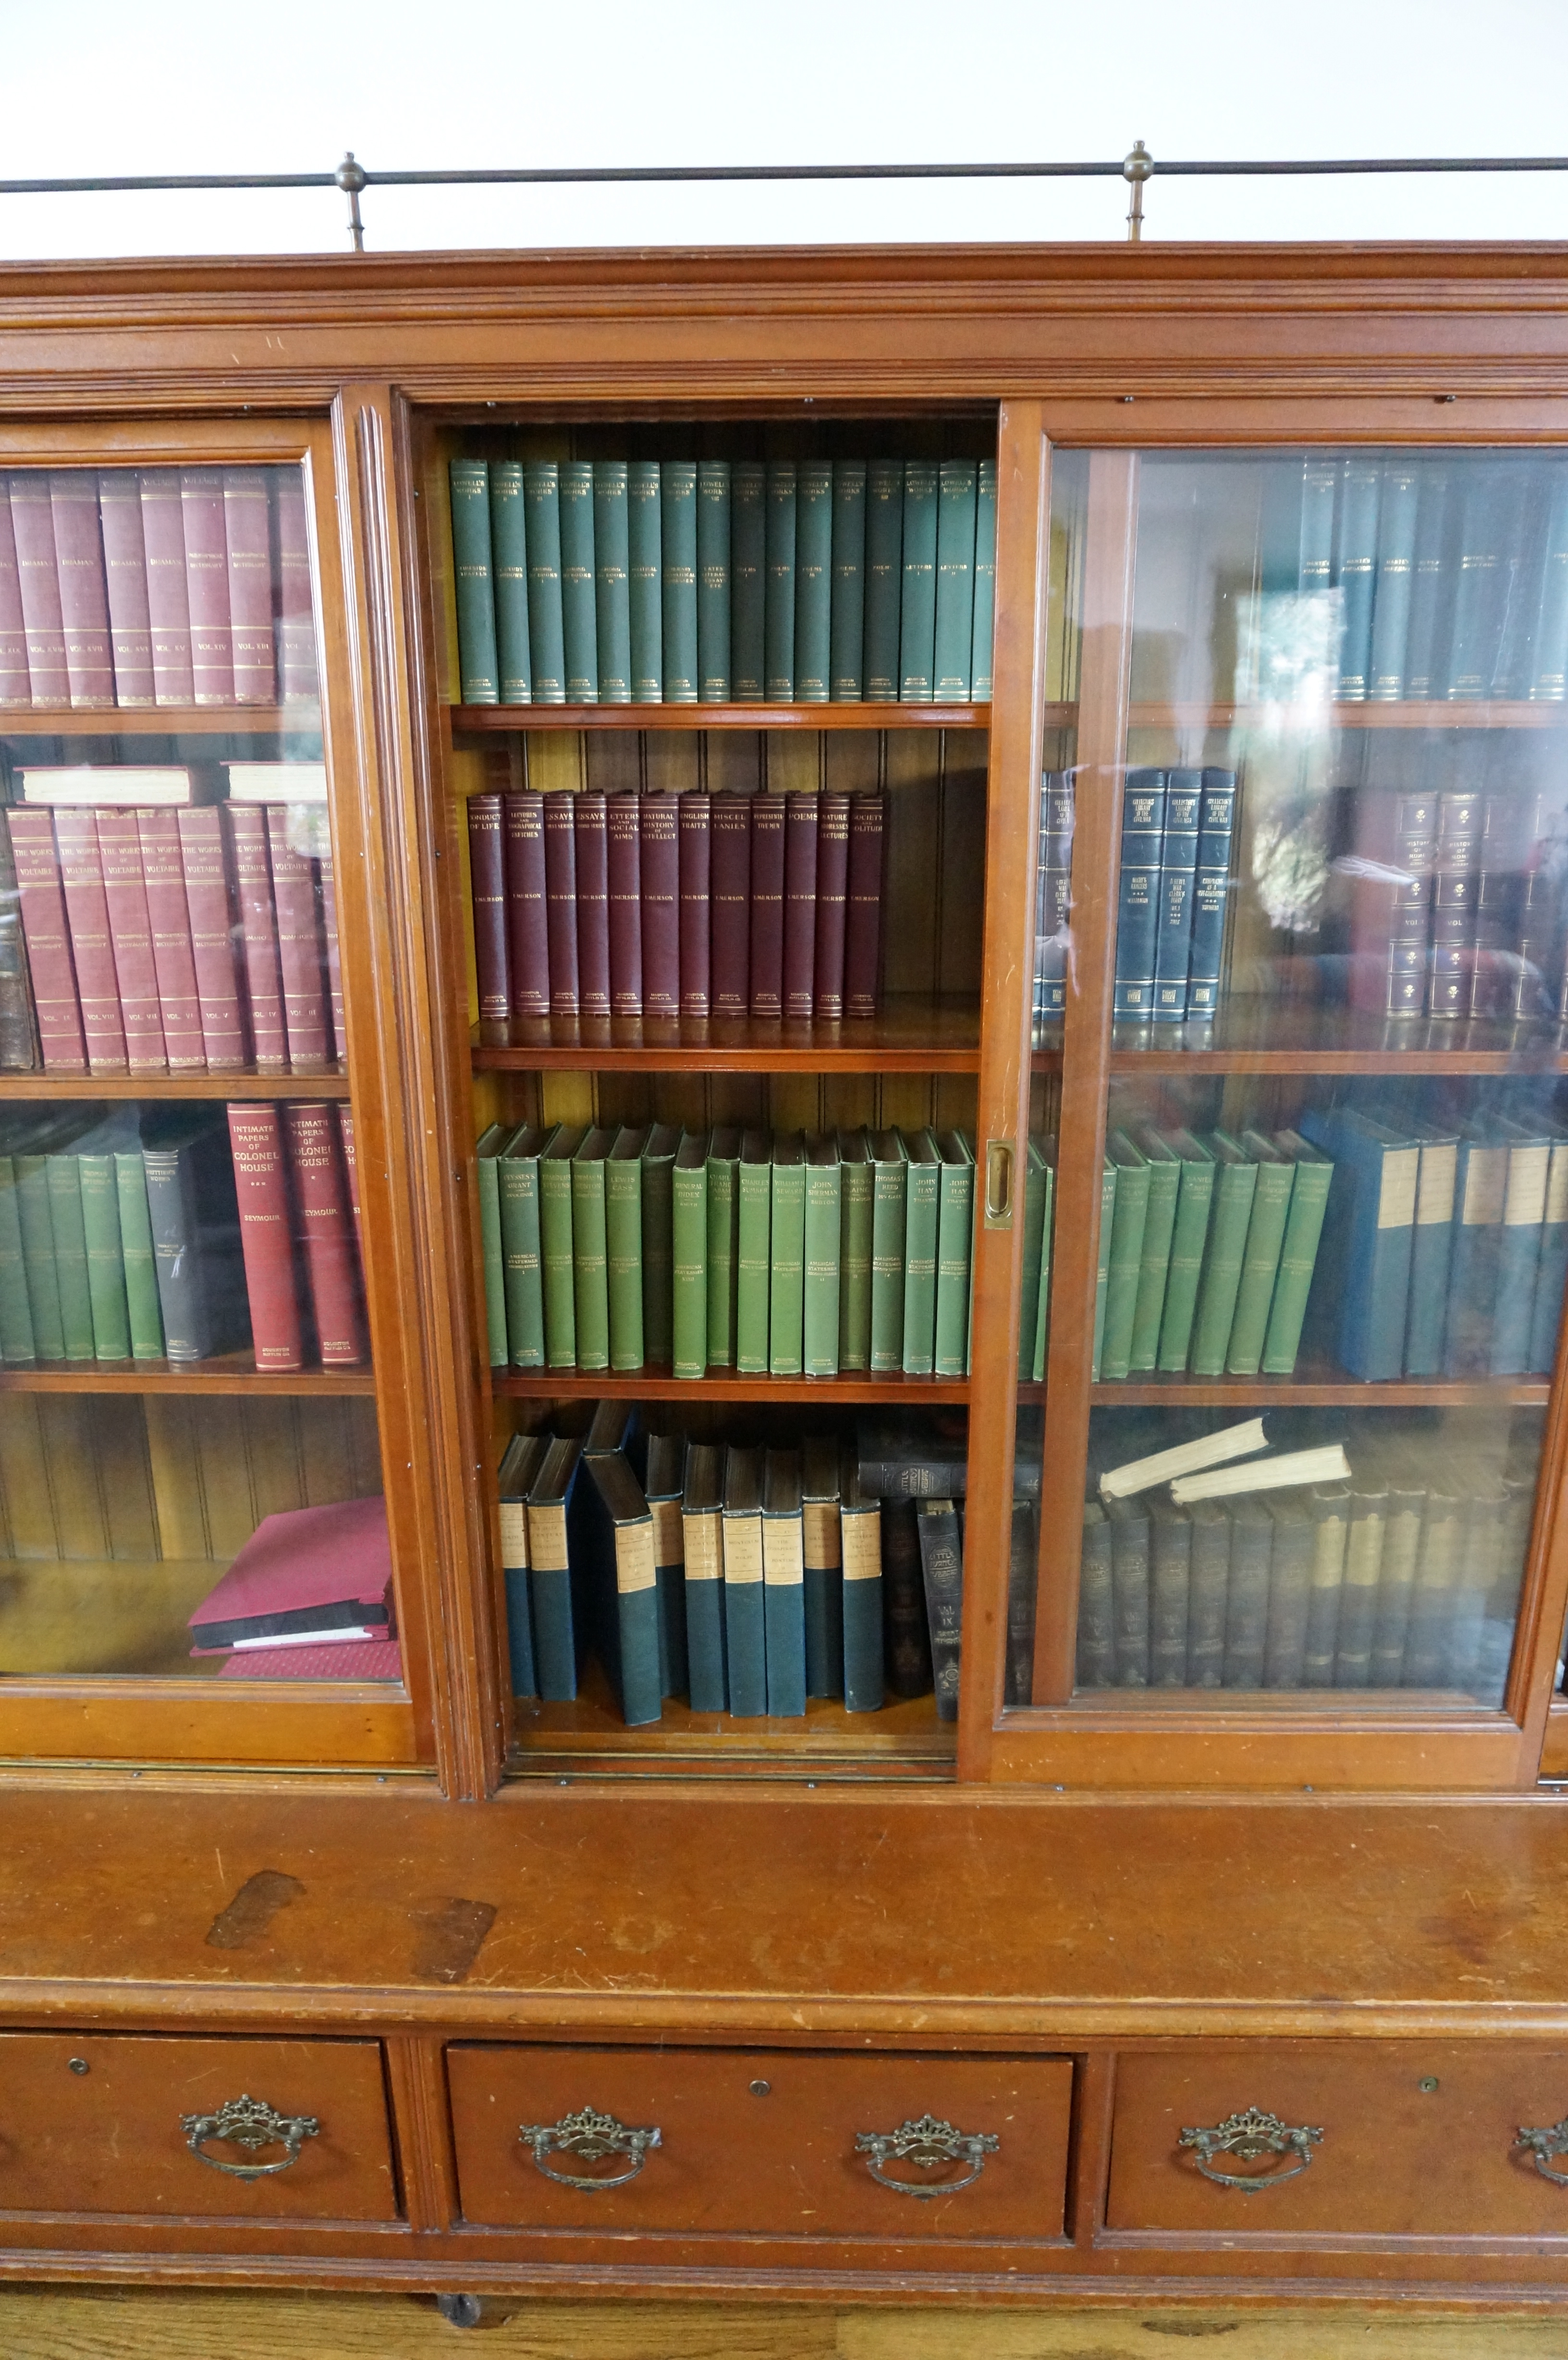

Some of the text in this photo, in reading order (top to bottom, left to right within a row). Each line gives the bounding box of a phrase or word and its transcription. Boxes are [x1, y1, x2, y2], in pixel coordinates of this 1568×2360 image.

[789, 812, 818, 821] POEMS
[293, 1129, 324, 1137] PAPERS
[234, 1151, 279, 1161] COLONEL
[240, 1163, 274, 1172] HOUSE
[812, 1181, 833, 1189] JOHN
[943, 1617, 953, 1626] IX
